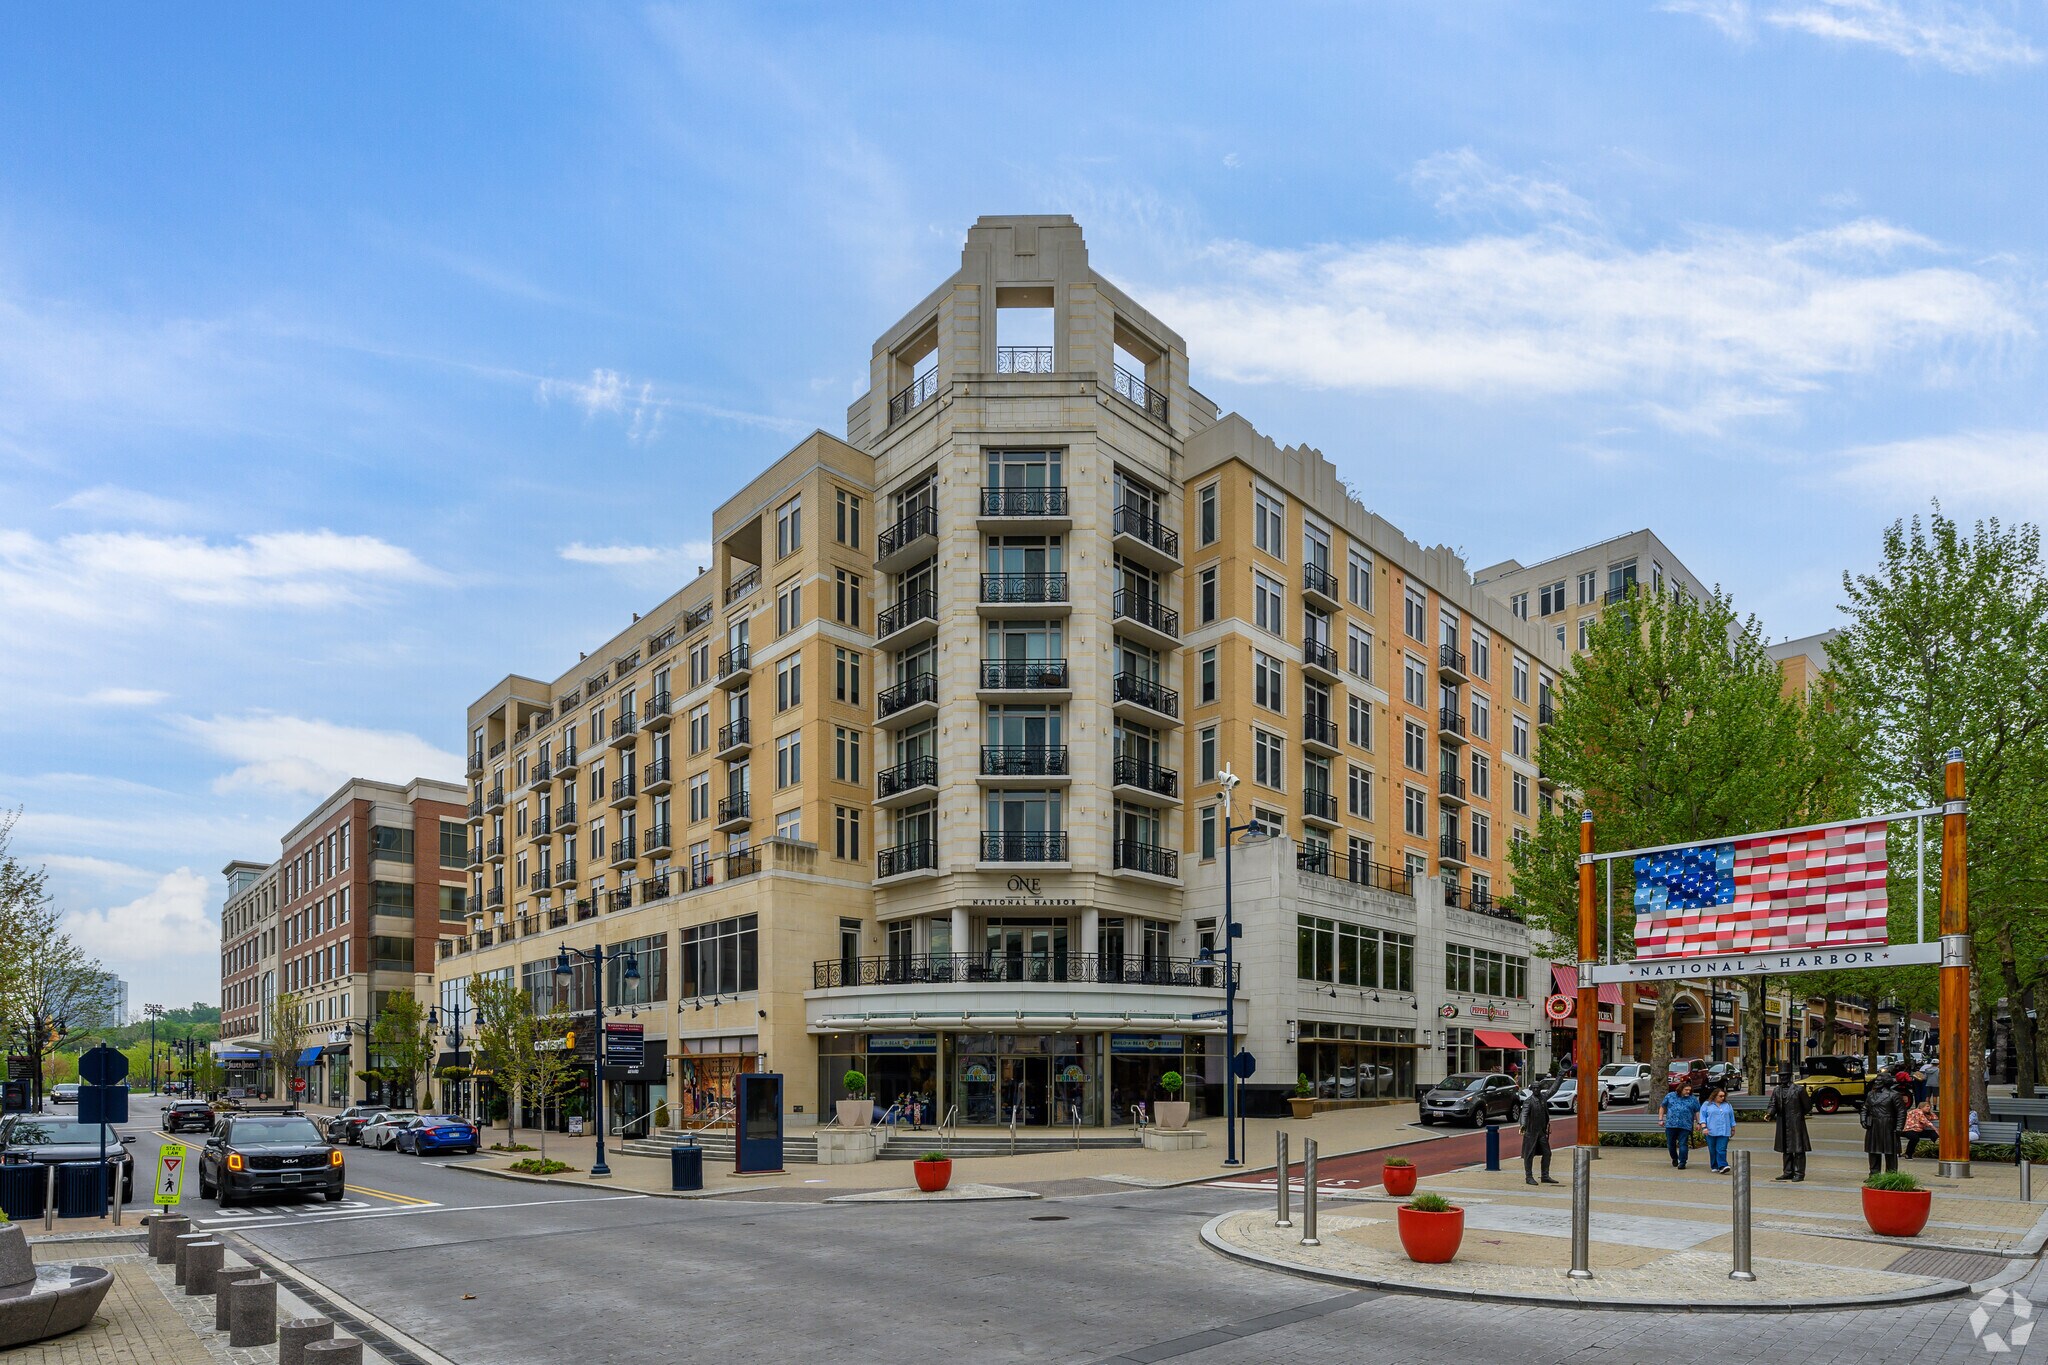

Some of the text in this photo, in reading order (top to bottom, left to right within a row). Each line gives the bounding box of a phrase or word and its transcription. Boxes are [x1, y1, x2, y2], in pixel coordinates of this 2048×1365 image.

[1007, 874, 1041, 895] ONE
[1640, 952, 1874, 977] NATIONAL HARBOR
[1471, 1006, 1509, 1017] PEPPER PALACE
[1598, 1011, 1613, 1020] TCHEN
